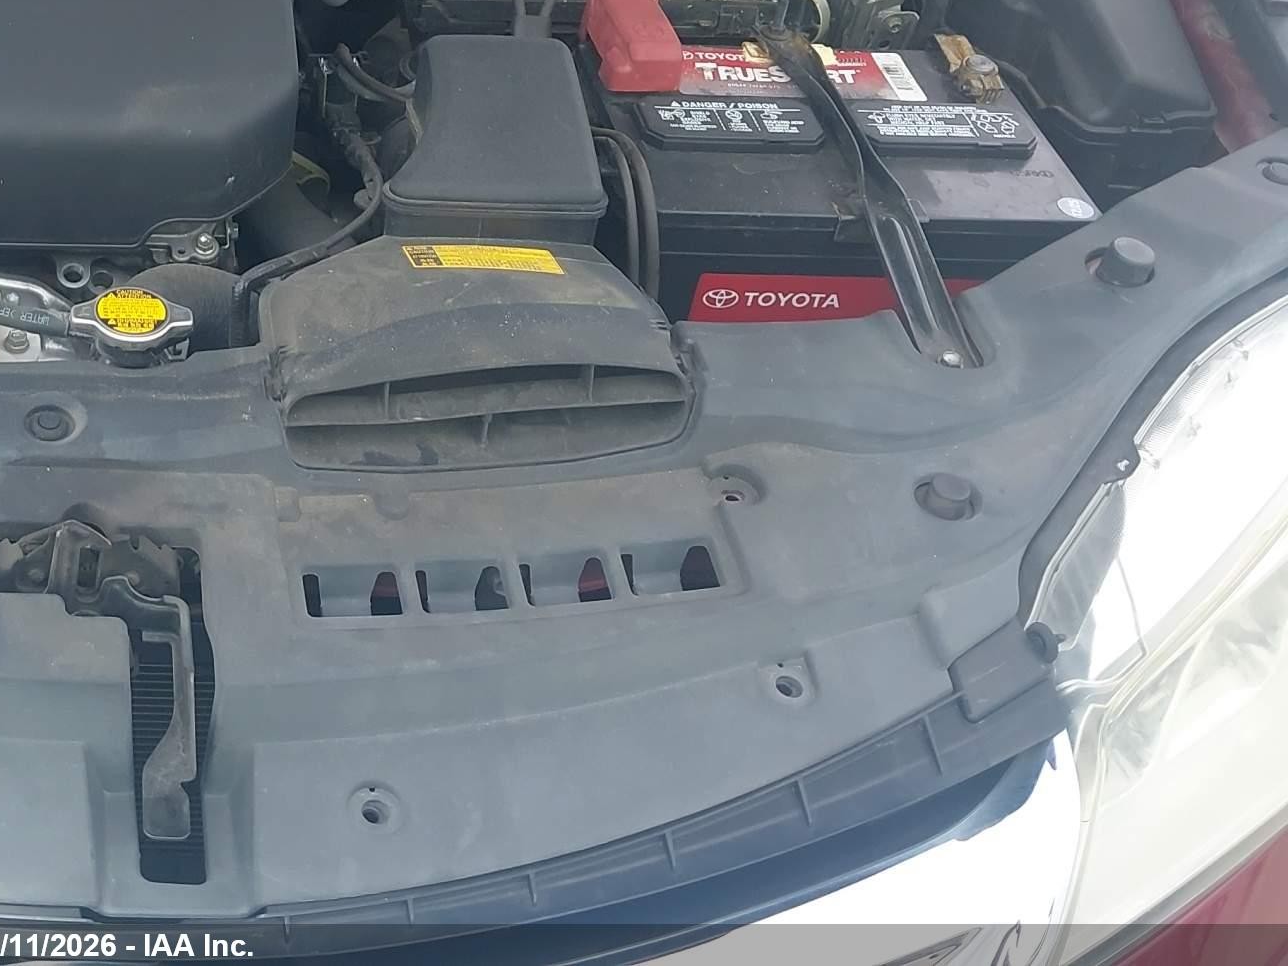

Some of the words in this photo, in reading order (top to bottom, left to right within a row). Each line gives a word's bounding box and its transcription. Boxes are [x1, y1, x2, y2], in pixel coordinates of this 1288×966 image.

[695, 52, 749, 62] TOYOT
[681, 100, 727, 109] DANGER
[737, 102, 779, 110] POISON
[744, 292, 840, 308] TOYOTA
